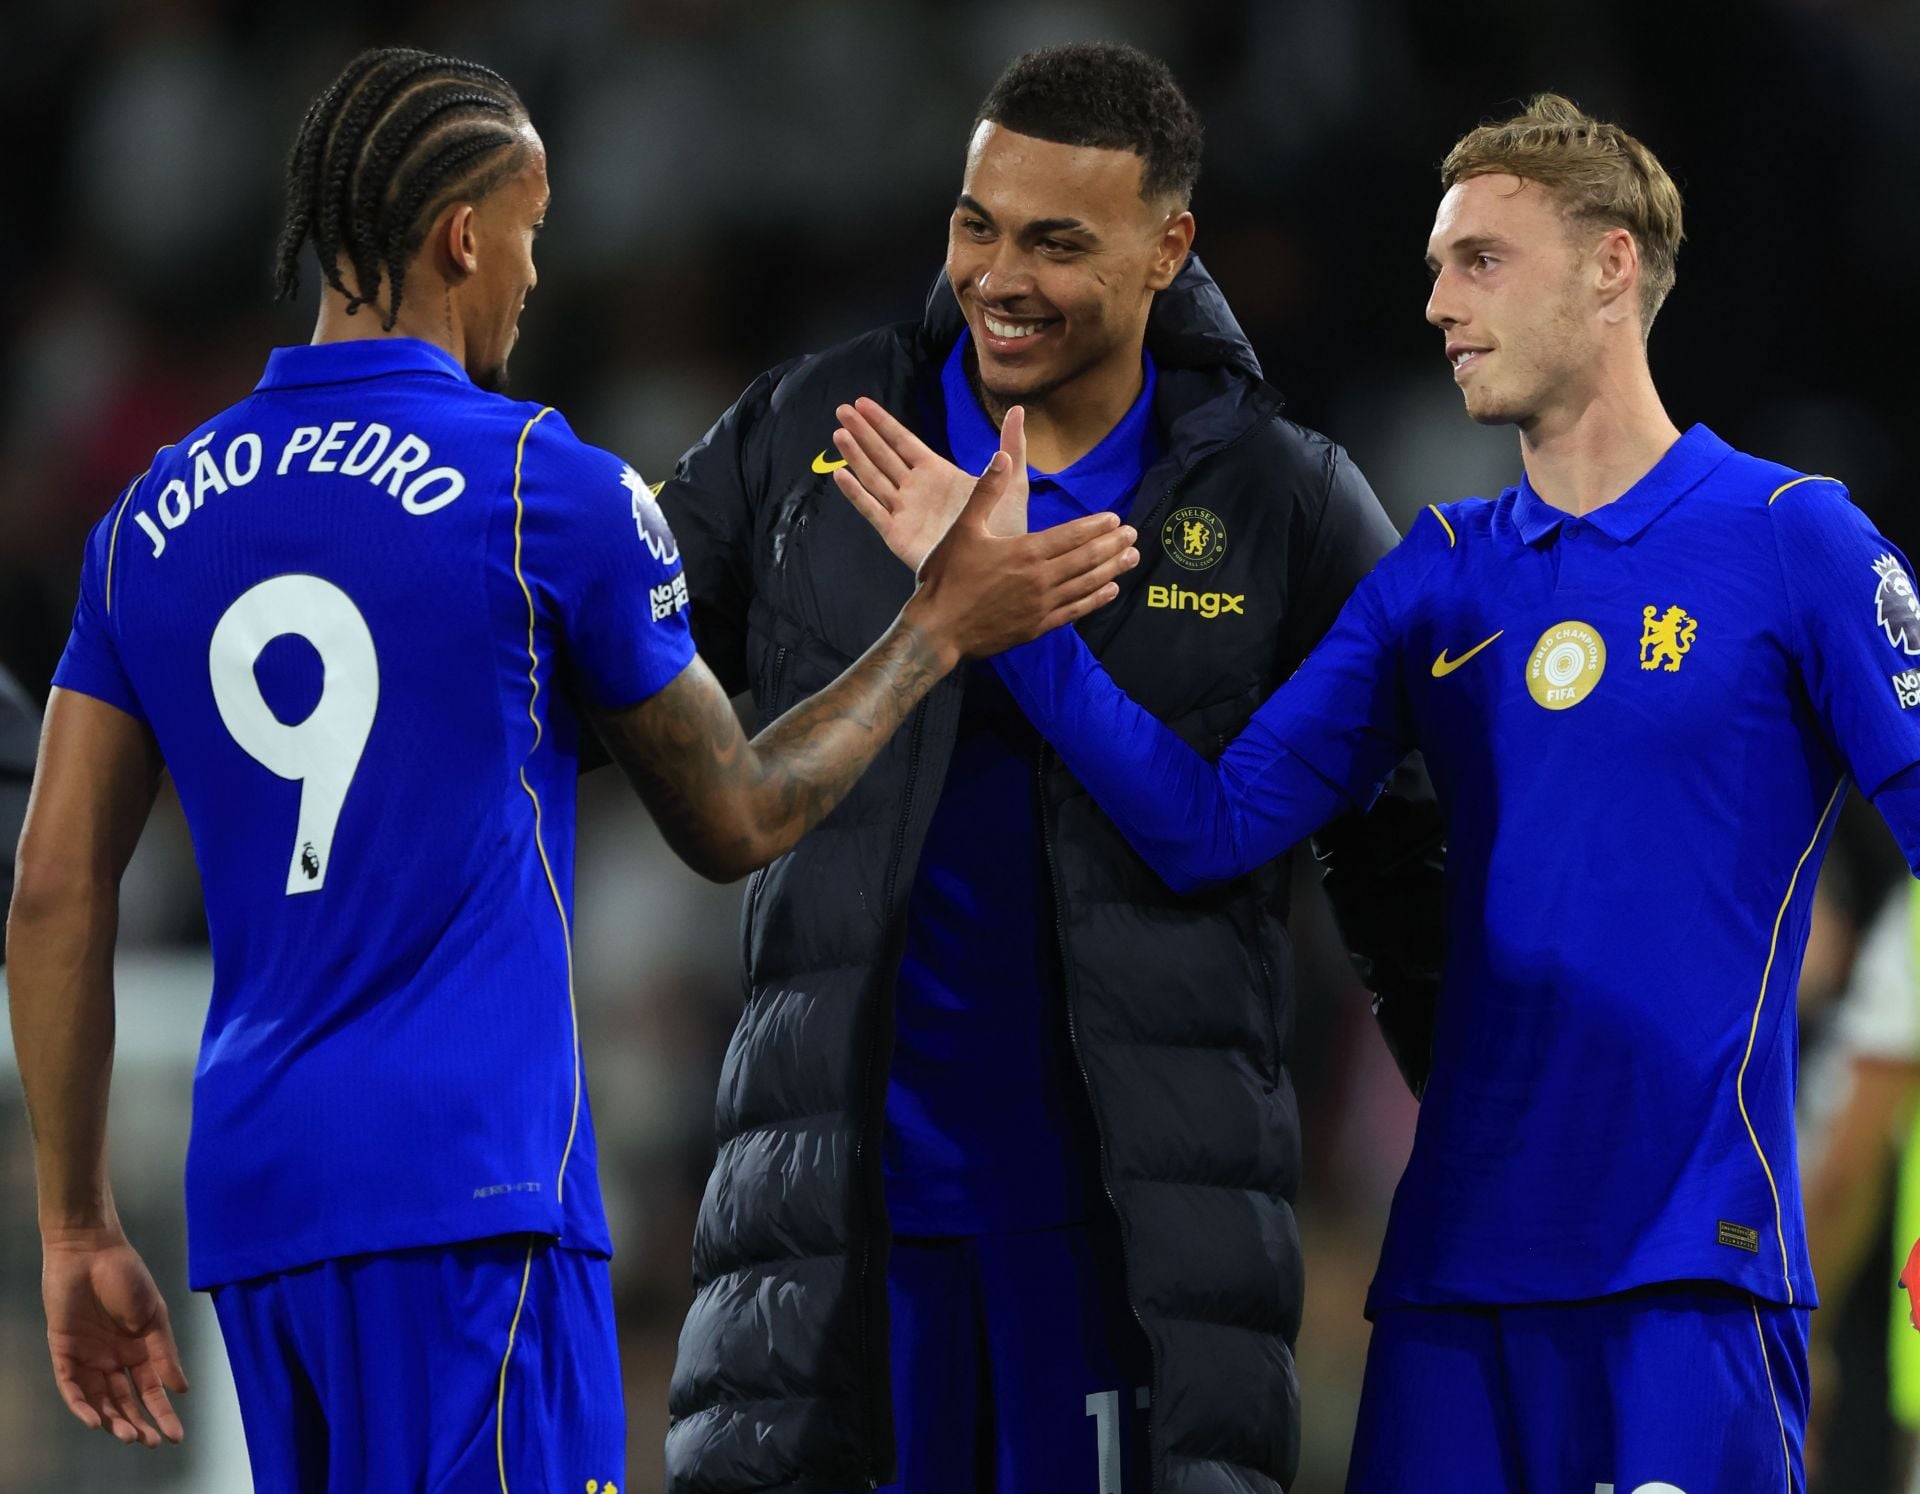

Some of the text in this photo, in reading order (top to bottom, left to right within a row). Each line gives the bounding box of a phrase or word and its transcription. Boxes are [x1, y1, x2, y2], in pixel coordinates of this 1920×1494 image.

[134, 421, 466, 558] JOÃO PEDRO
[1175, 509, 1215, 524] CHELSEA
[650, 585, 672, 603] No
[1532, 629, 1598, 679] WORLD CHAMPIONS
[1892, 672, 1919, 690] No
[1547, 687, 1577, 702] FIFA
[209, 574, 379, 896] 9
